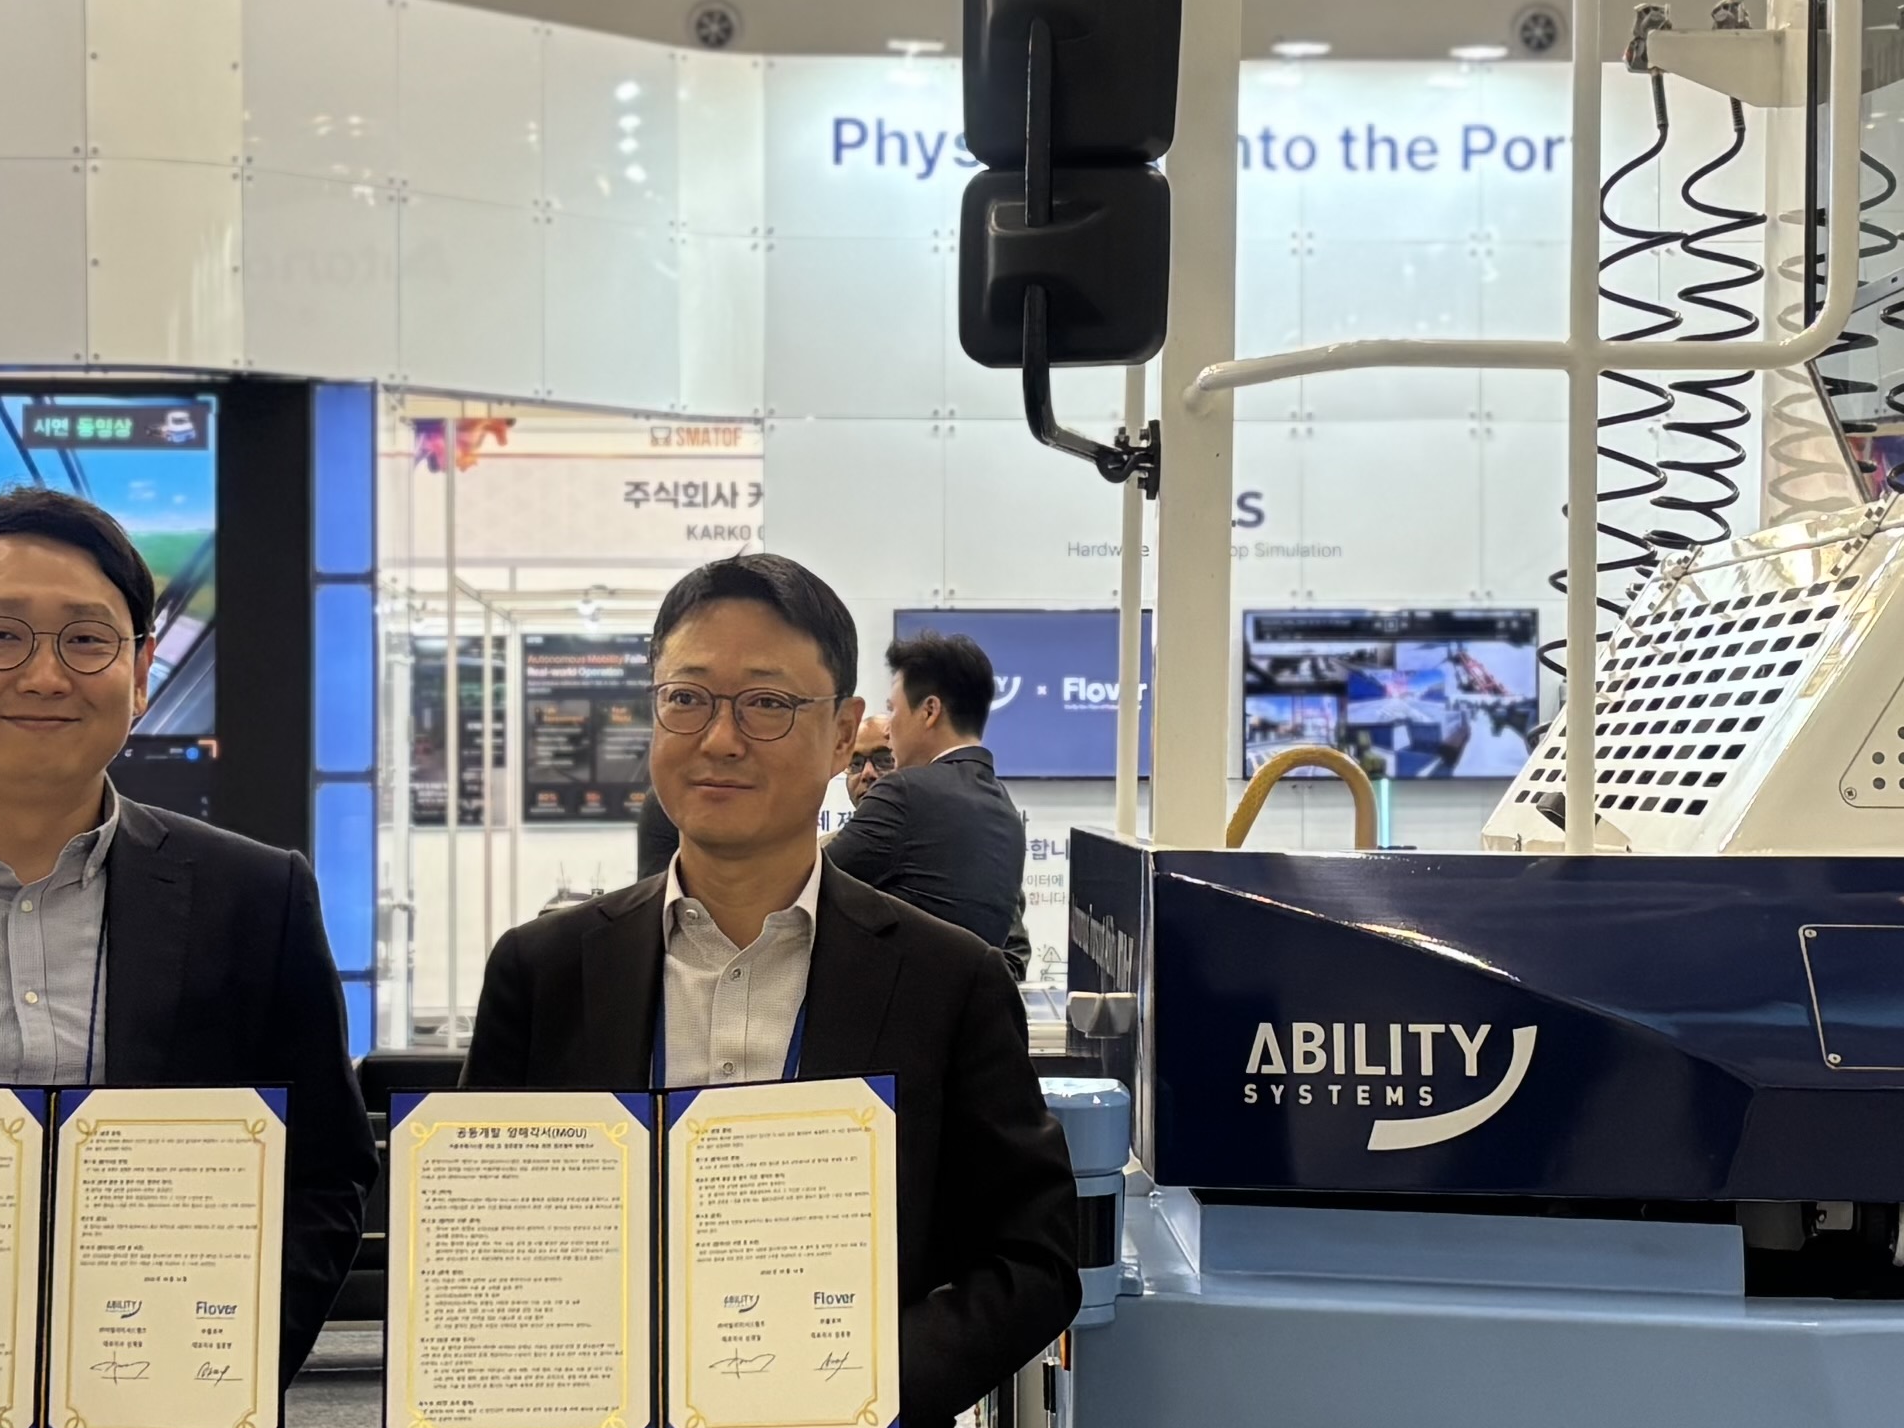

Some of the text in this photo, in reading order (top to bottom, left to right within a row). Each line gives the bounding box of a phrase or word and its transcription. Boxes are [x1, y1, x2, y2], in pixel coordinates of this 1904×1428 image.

[832, 118, 1571, 180] Phys nto the Por
[34, 416, 134, 438] 시연 동영상
[676, 426, 743, 447] SMATOF
[624, 481, 739, 509] 주식회사
[687, 524, 751, 541] KARKO
[1068, 542, 1150, 557] Hardwe
[1254, 542, 1342, 558] Simulation
[1063, 677, 1148, 703] Flovr
[1025, 838, 1070, 860] 합니
[1026, 874, 1064, 887] 이터에
[1245, 1022, 1492, 1077] ABILITY
[1243, 1083, 1435, 1107] SYSTEMS
[196, 1301, 238, 1315] Flover
[813, 1291, 856, 1306] Flover
